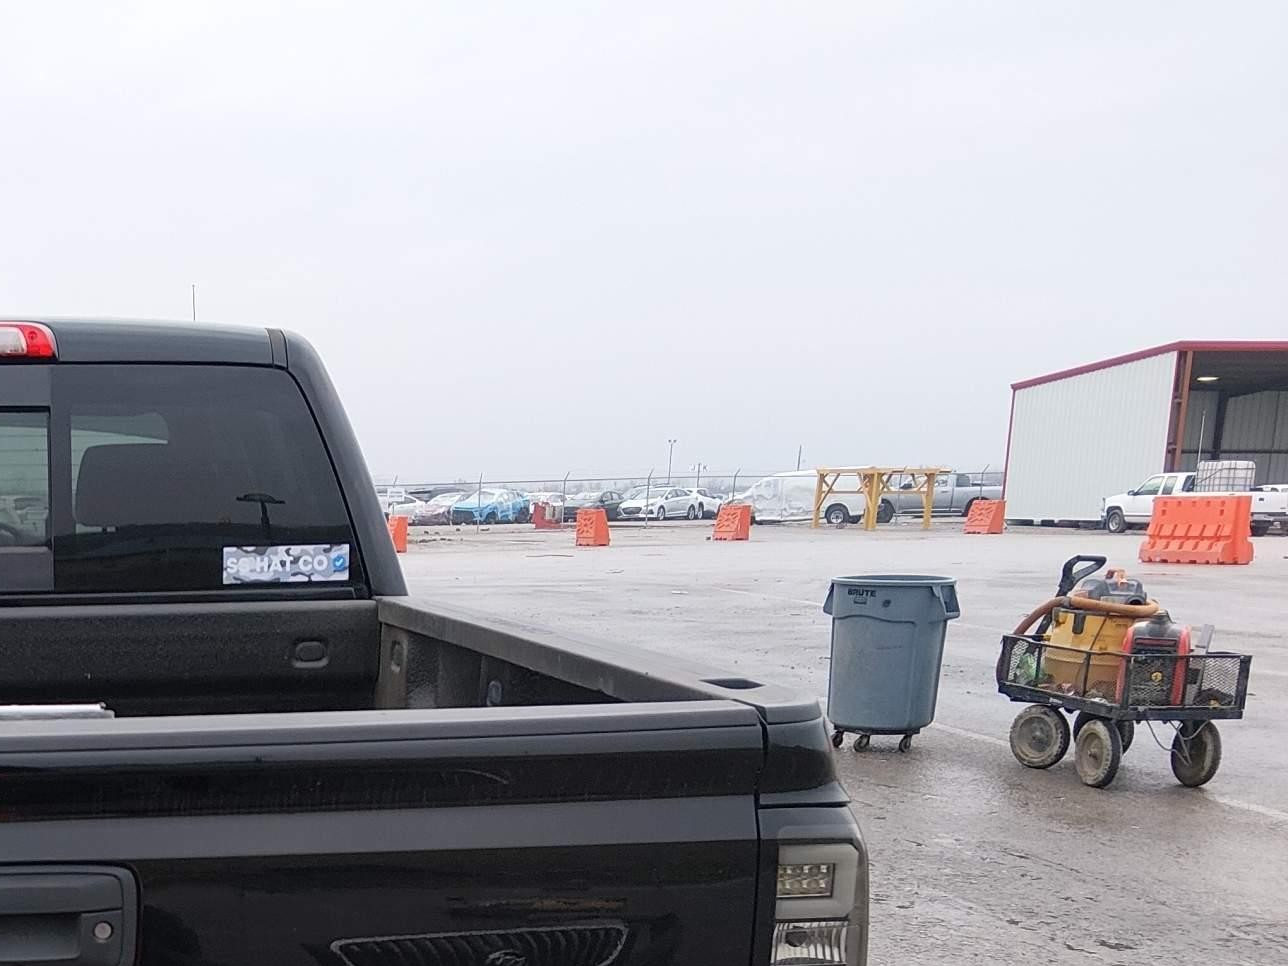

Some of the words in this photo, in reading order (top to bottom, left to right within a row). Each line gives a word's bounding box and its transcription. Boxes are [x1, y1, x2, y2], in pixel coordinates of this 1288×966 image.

[256, 555, 294, 572] HAT
[298, 554, 328, 571] CO
[847, 588, 877, 598] BRUTE
